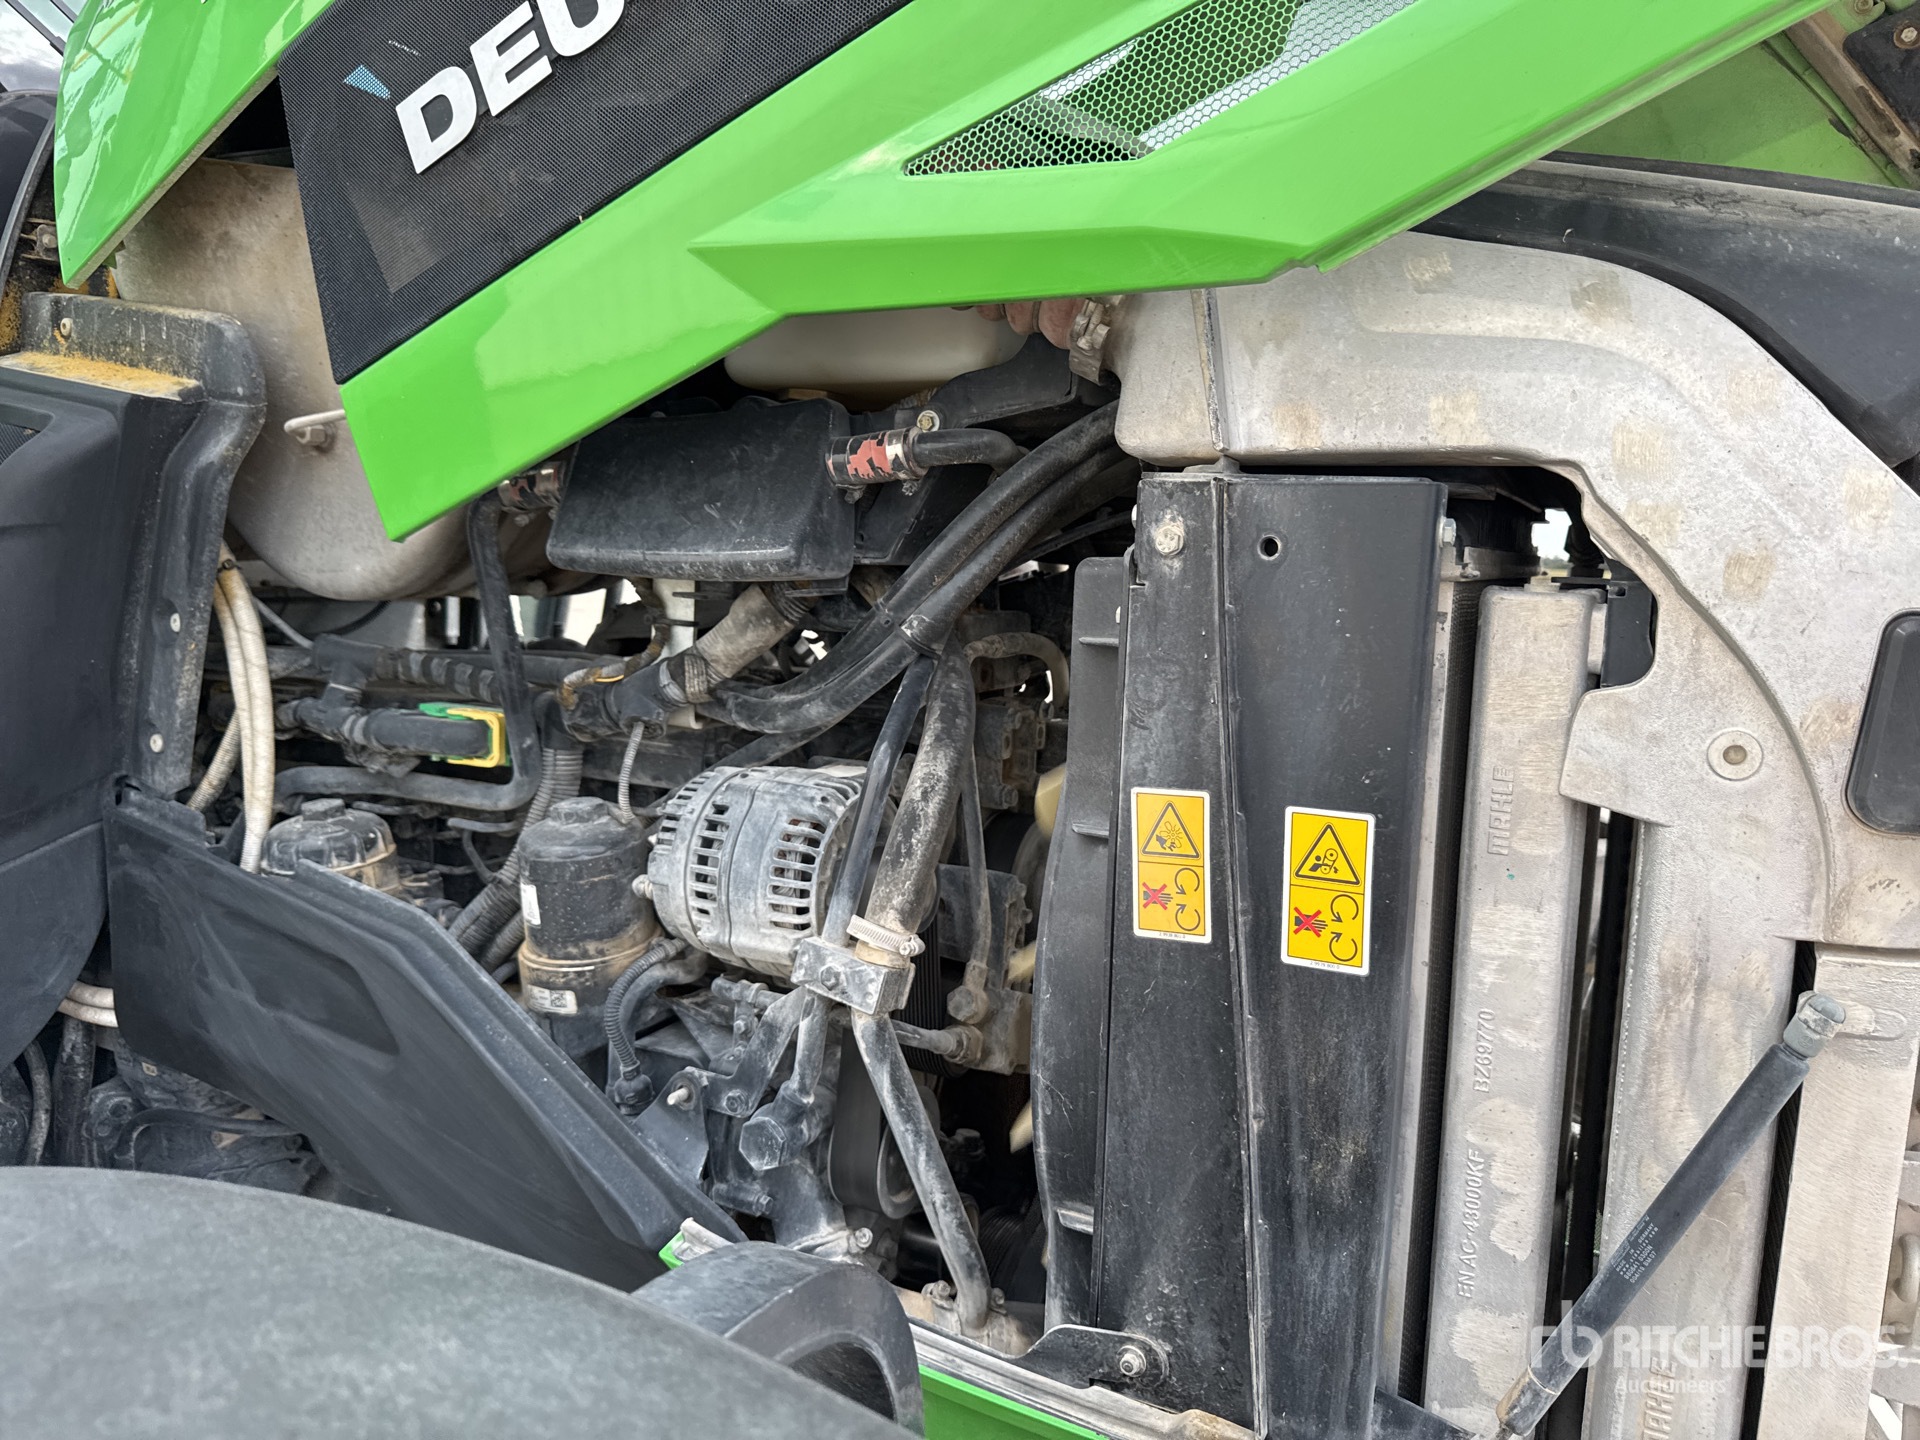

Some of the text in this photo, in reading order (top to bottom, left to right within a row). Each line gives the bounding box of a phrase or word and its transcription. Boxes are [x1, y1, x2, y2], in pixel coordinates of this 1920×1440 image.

[396, 0, 625, 175] DEU
[1487, 765, 1515, 856] MAHLE
[1473, 1009, 1496, 1094] BZ69770
[1457, 1270, 1475, 1299] EN
[1615, 1260, 1627, 1272] MADE
[1637, 1222, 1654, 1244] GERMANY
